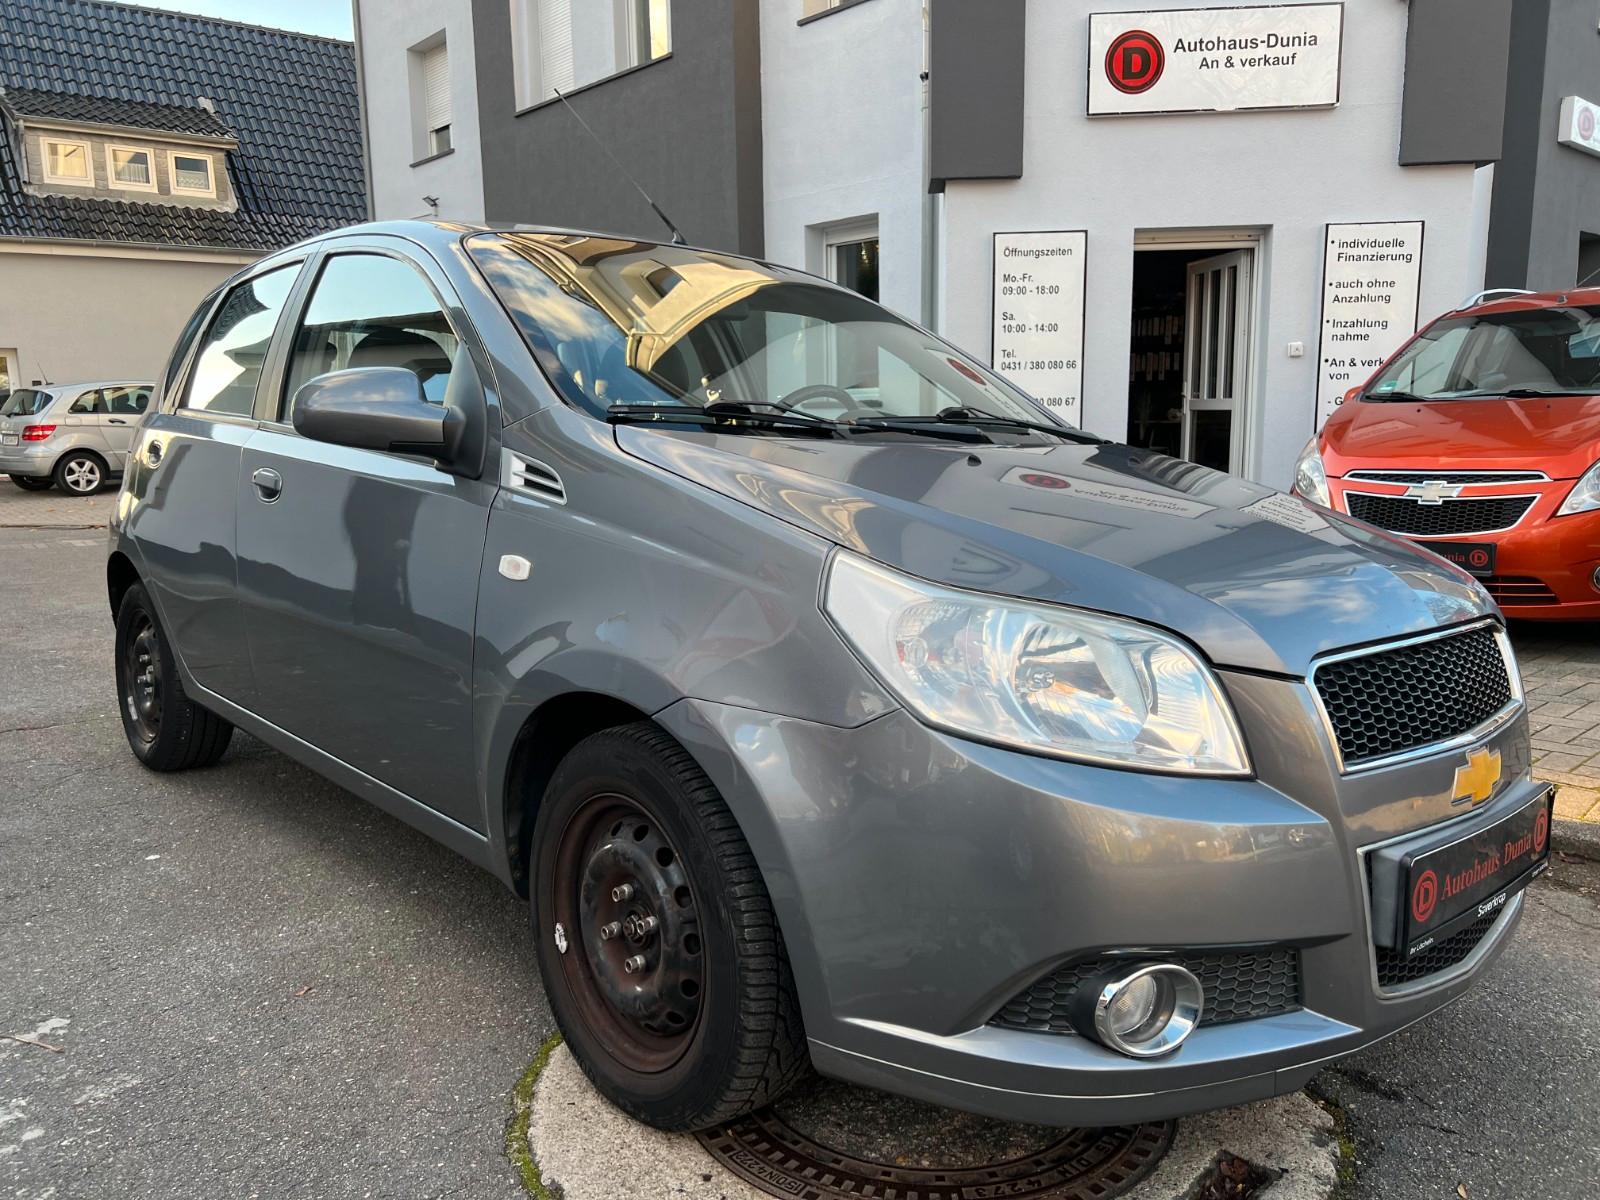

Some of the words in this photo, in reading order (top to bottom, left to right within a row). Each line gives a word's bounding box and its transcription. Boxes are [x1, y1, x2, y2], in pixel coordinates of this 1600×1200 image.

[1173, 31, 1318, 53] Autohaus-Dunia
[1121, 46, 1152, 81] D
[1199, 57, 1219, 70] An
[1224, 55, 1235, 68] &
[1240, 52, 1297, 67] verkauf
[1338, 238, 1405, 249] individuelle
[1003, 246, 1073, 259] Öffnungszeiten
[1337, 252, 1413, 263] Finanzierung
[1002, 273, 1034, 283] Mo.-Fr.
[1335, 279, 1363, 289] auch
[1366, 278, 1396, 288] ohne
[1002, 285, 1027, 296] 09:00
[1035, 284, 1060, 295] 18:00
[1332, 293, 1391, 304] Anzahlung
[1002, 311, 1016, 321] Sa.
[1002, 324, 1026, 334] 10:00
[1034, 323, 1059, 333] 14:00
[1332, 318, 1388, 330] Inzahlung
[1331, 331, 1370, 342] nahme
[1001, 349, 1017, 359] Tel.
[1001, 361, 1022, 371] 0431
[1029, 360, 1045, 370] 380
[1048, 360, 1064, 370] 080
[1066, 360, 1077, 369] 66
[1329, 358, 1345, 367] An
[1348, 357, 1357, 367] &
[1360, 357, 1385, 367] verk
[1329, 372, 1350, 380] von
[1046, 396, 1063, 407] 080
[1065, 396, 1076, 406] 67
[1443, 552, 1466, 563] nia
[1440, 853, 1500, 900] Autohaus
[1503, 832, 1532, 865] Dunia
